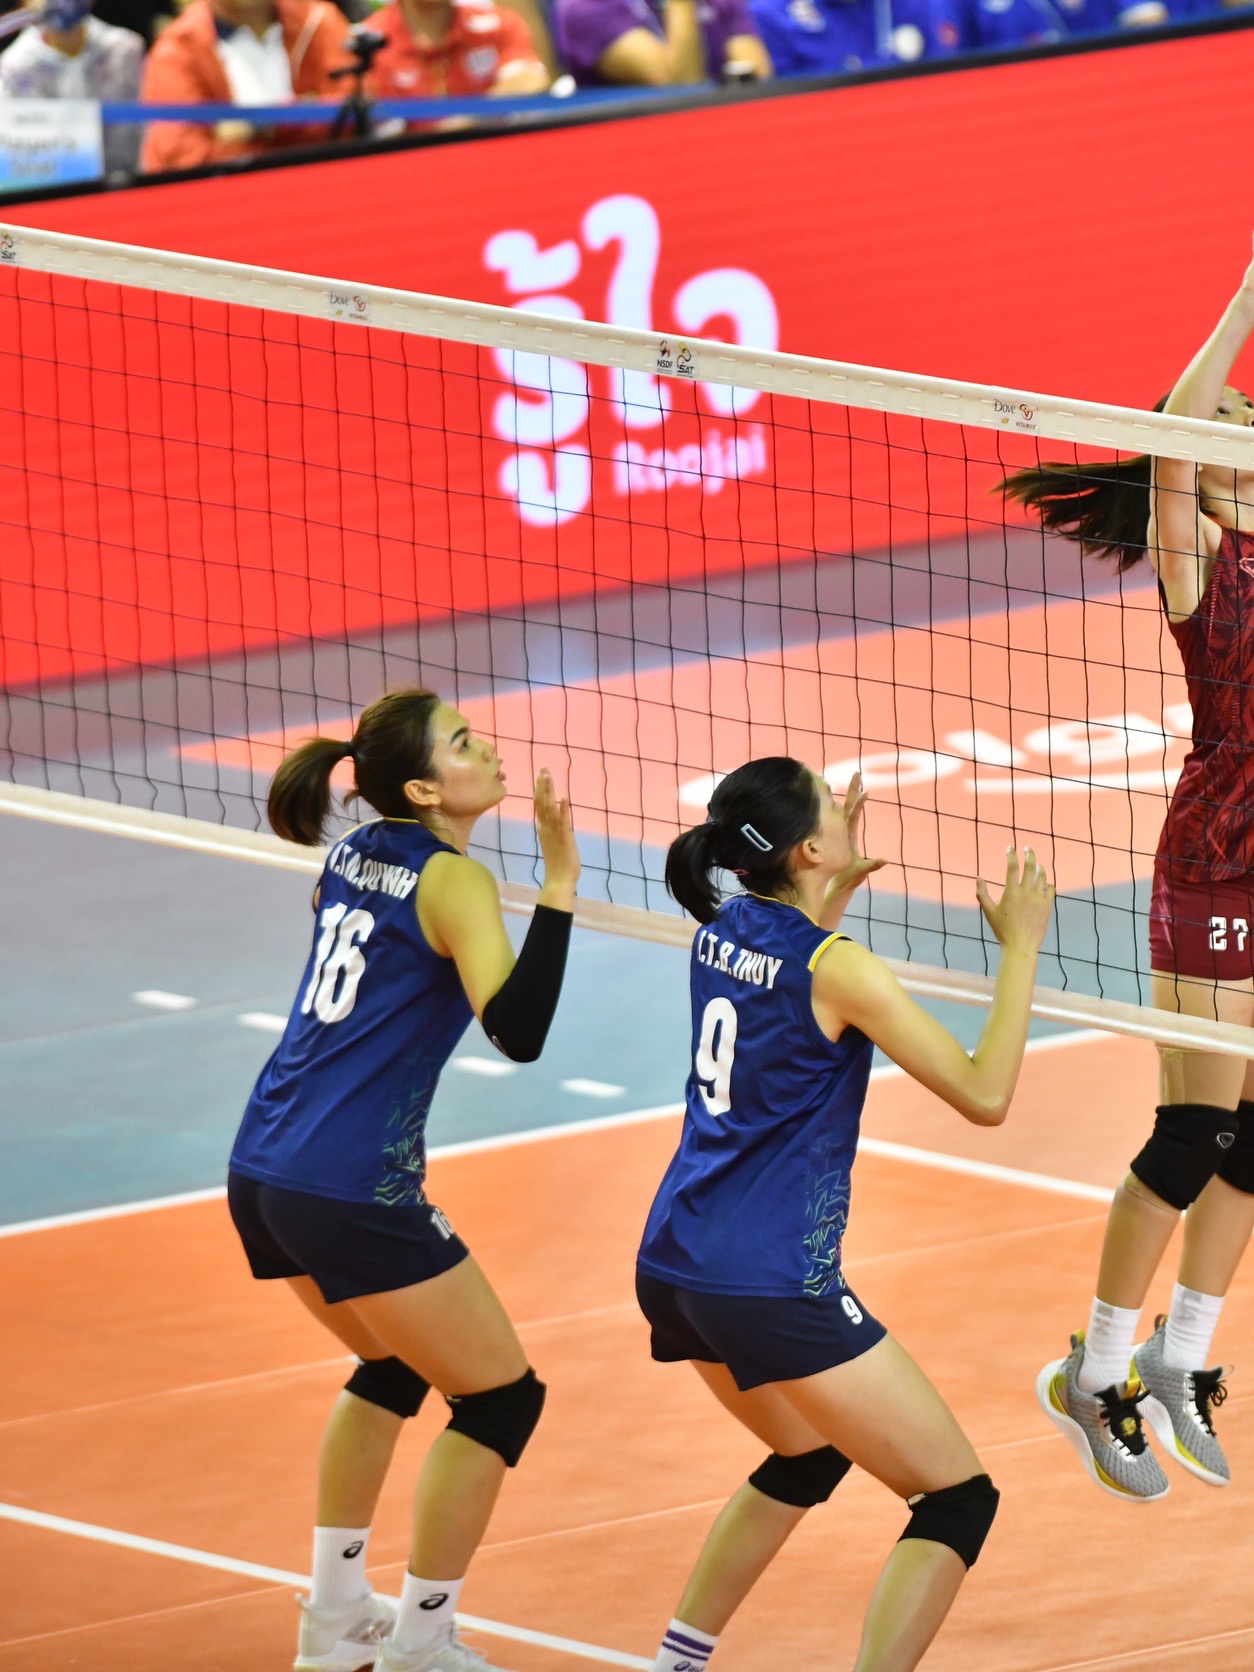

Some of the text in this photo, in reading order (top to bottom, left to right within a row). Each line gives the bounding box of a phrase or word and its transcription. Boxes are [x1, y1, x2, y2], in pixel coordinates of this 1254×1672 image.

[657, 360, 673, 368] NSDF
[677, 364, 694, 374] SAT
[993, 398, 1016, 414] Dove
[612, 422, 767, 495] Roojai
[1208, 916, 1249, 951] 27
[301, 902, 375, 1024] 16
[696, 997, 738, 1117] 9
[841, 1295, 864, 1324] 9
